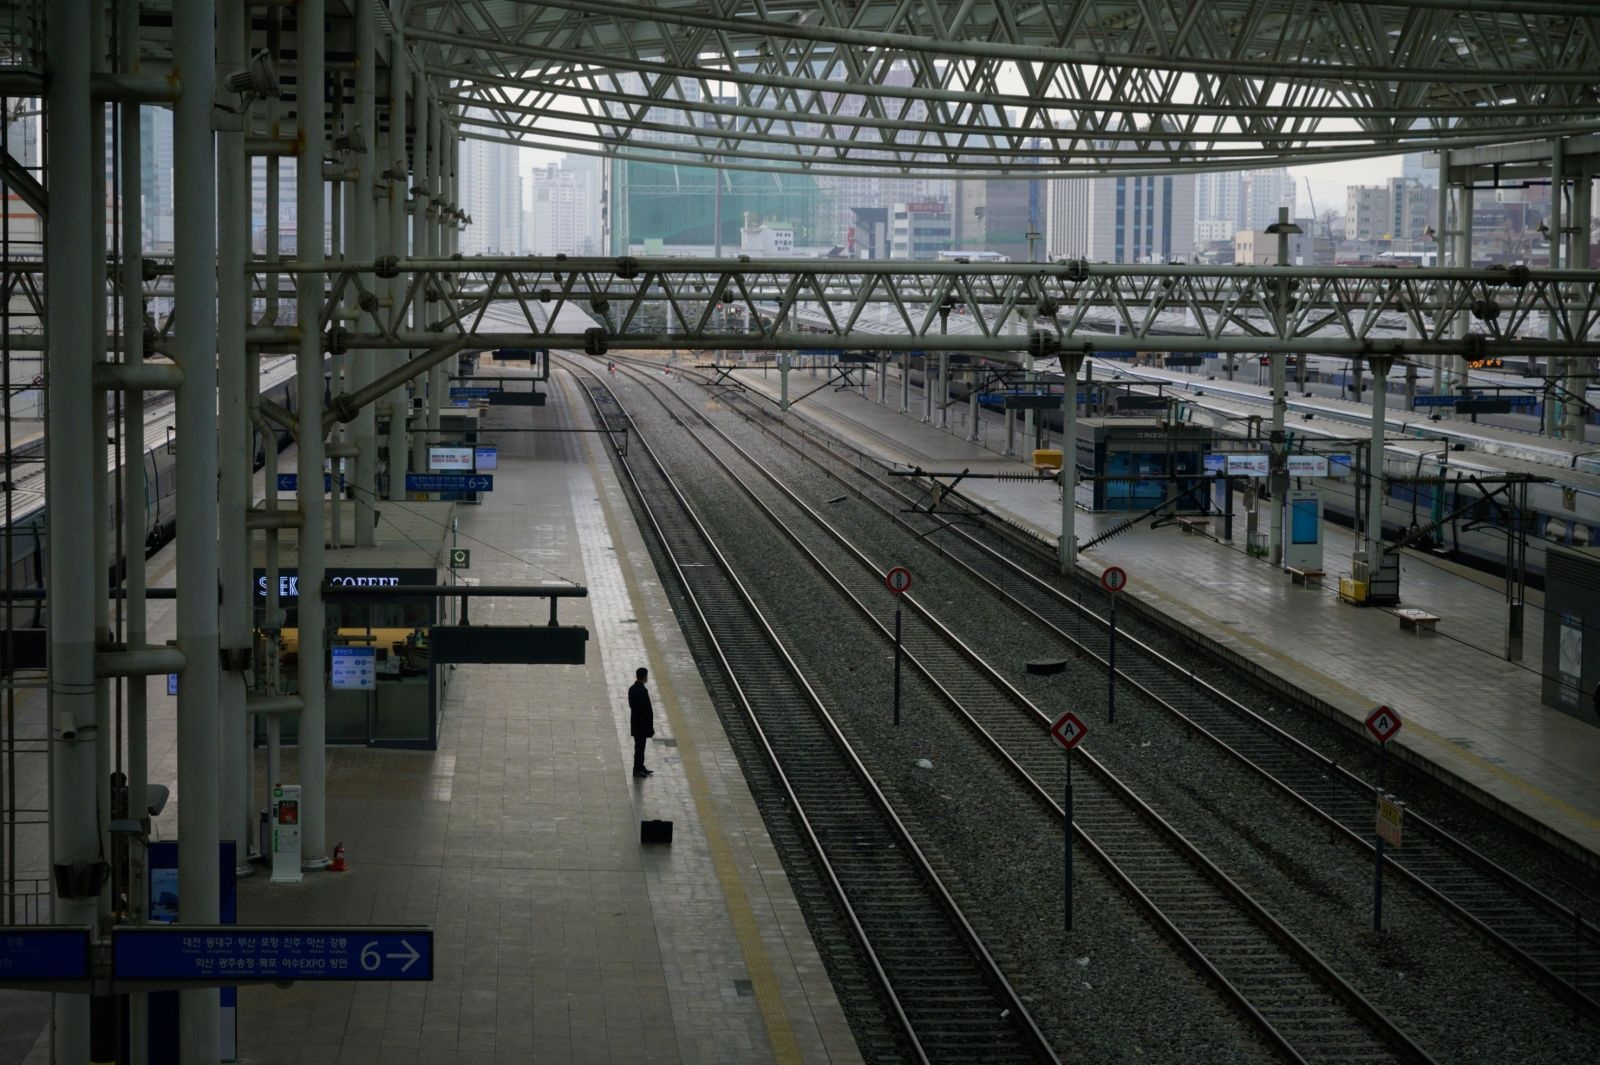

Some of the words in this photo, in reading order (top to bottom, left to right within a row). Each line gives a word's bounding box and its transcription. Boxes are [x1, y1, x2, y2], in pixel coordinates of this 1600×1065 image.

[468, 478, 477, 489] 6
[1378, 716, 1389, 729] A
[1064, 723, 1075, 736] A
[360, 940, 381, 971] 6
